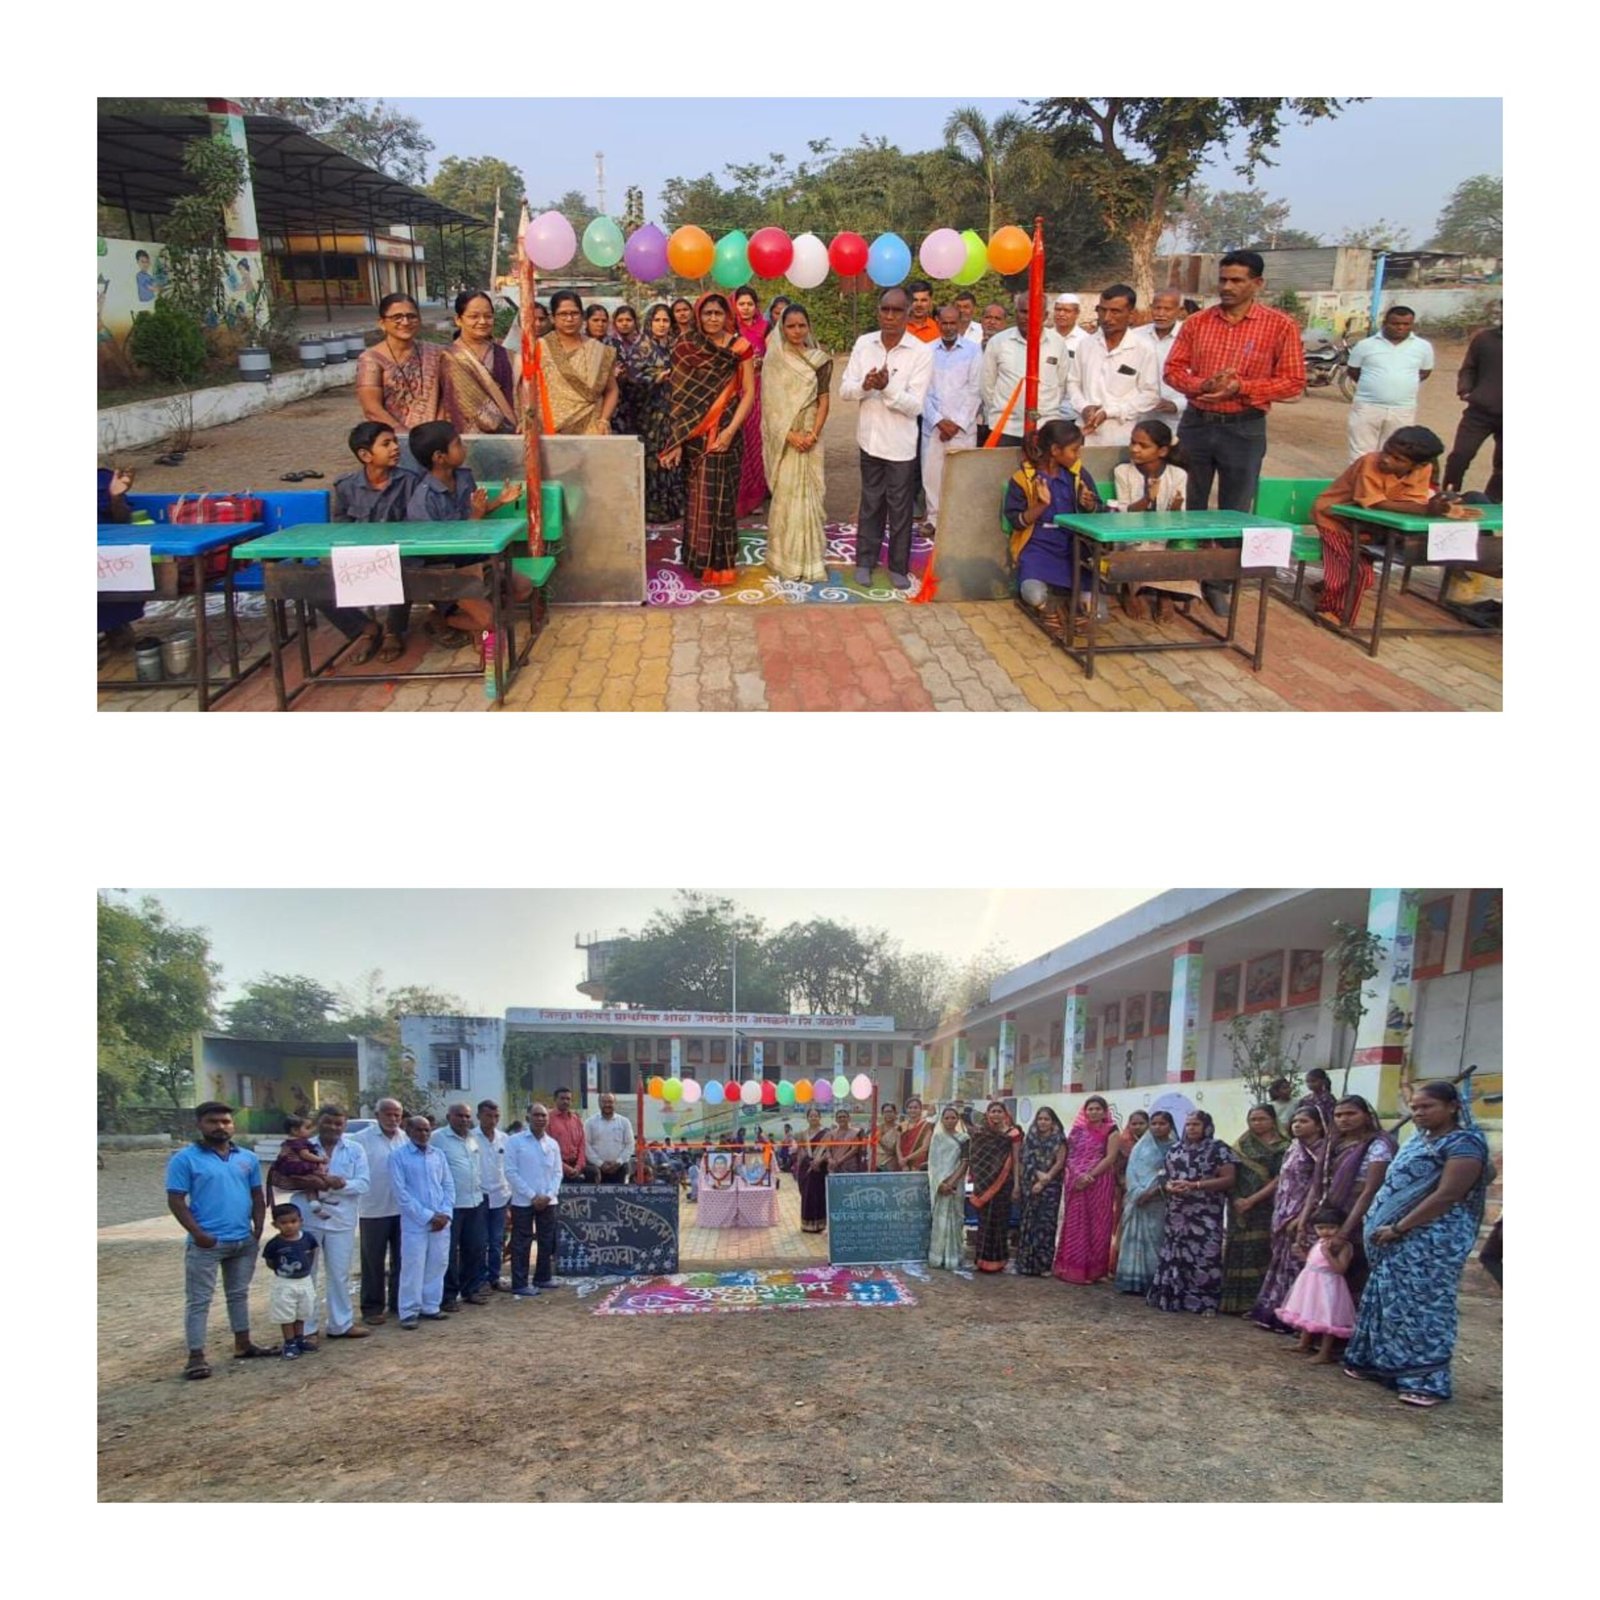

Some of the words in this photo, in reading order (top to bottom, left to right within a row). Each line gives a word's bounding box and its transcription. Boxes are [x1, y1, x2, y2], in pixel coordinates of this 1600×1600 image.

[539, 1009, 571, 1021] जिल्हा
[576, 1010, 610, 1022] परिषद
[614, 1010, 660, 1022] प्राथमिक
[663, 1013, 691, 1023] शाळा
[816, 1016, 856, 1027] जळगाव
[560, 1197, 597, 1219] बाल
